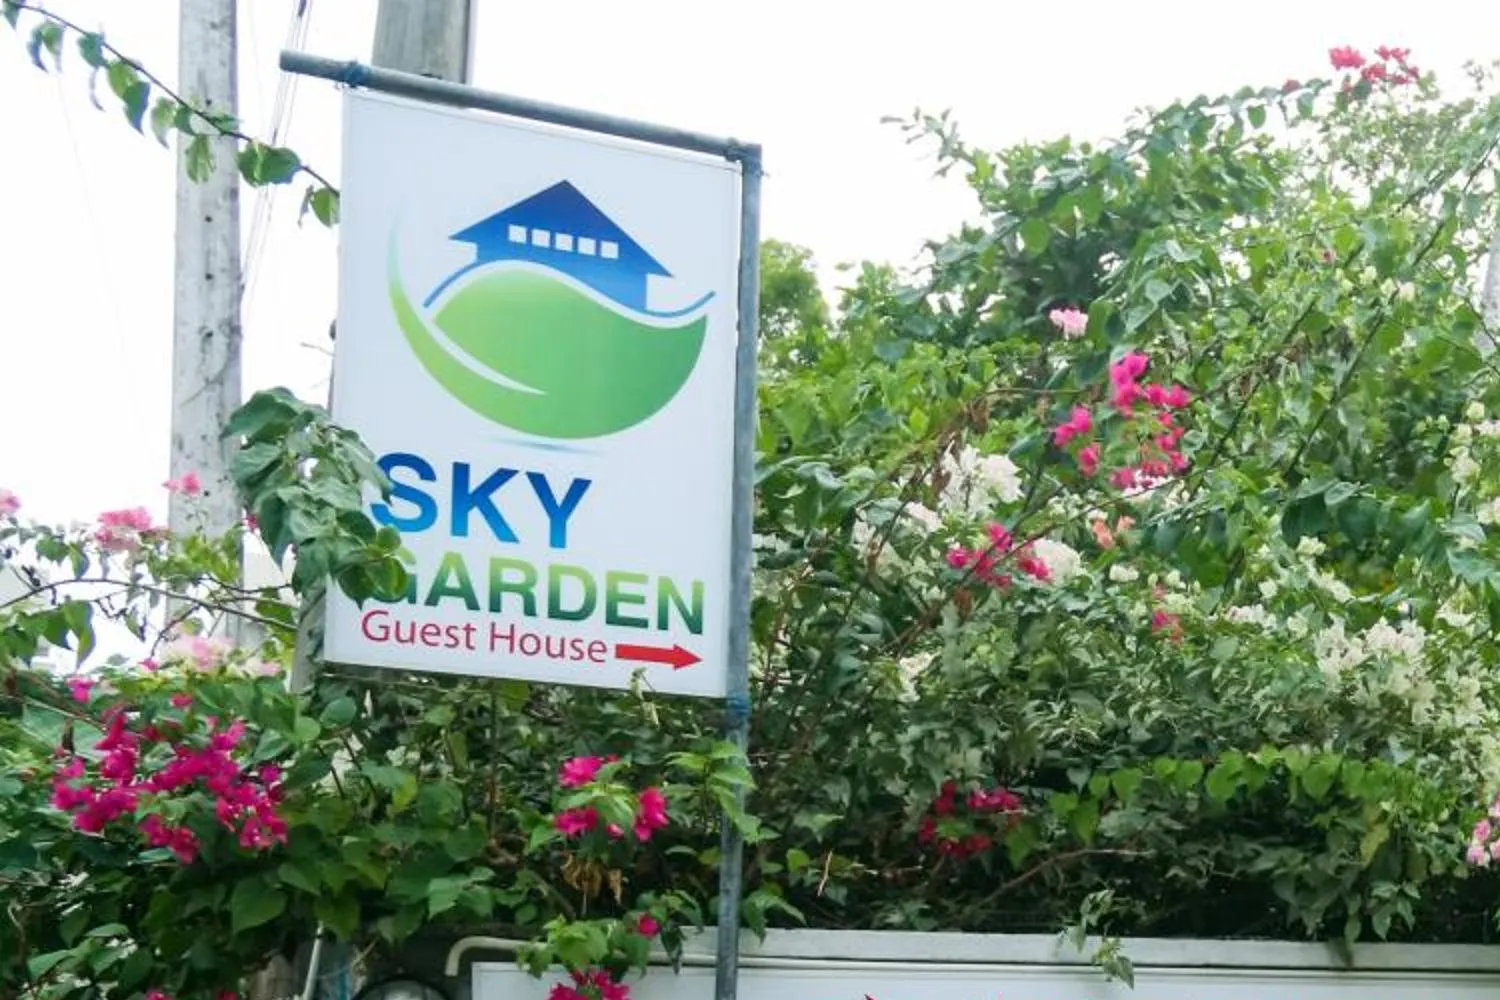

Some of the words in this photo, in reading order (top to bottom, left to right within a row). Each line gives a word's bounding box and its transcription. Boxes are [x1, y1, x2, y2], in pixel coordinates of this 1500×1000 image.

[369, 451, 593, 549] SKY
[361, 609, 476, 651] Guest
[489, 621, 609, 664] House
